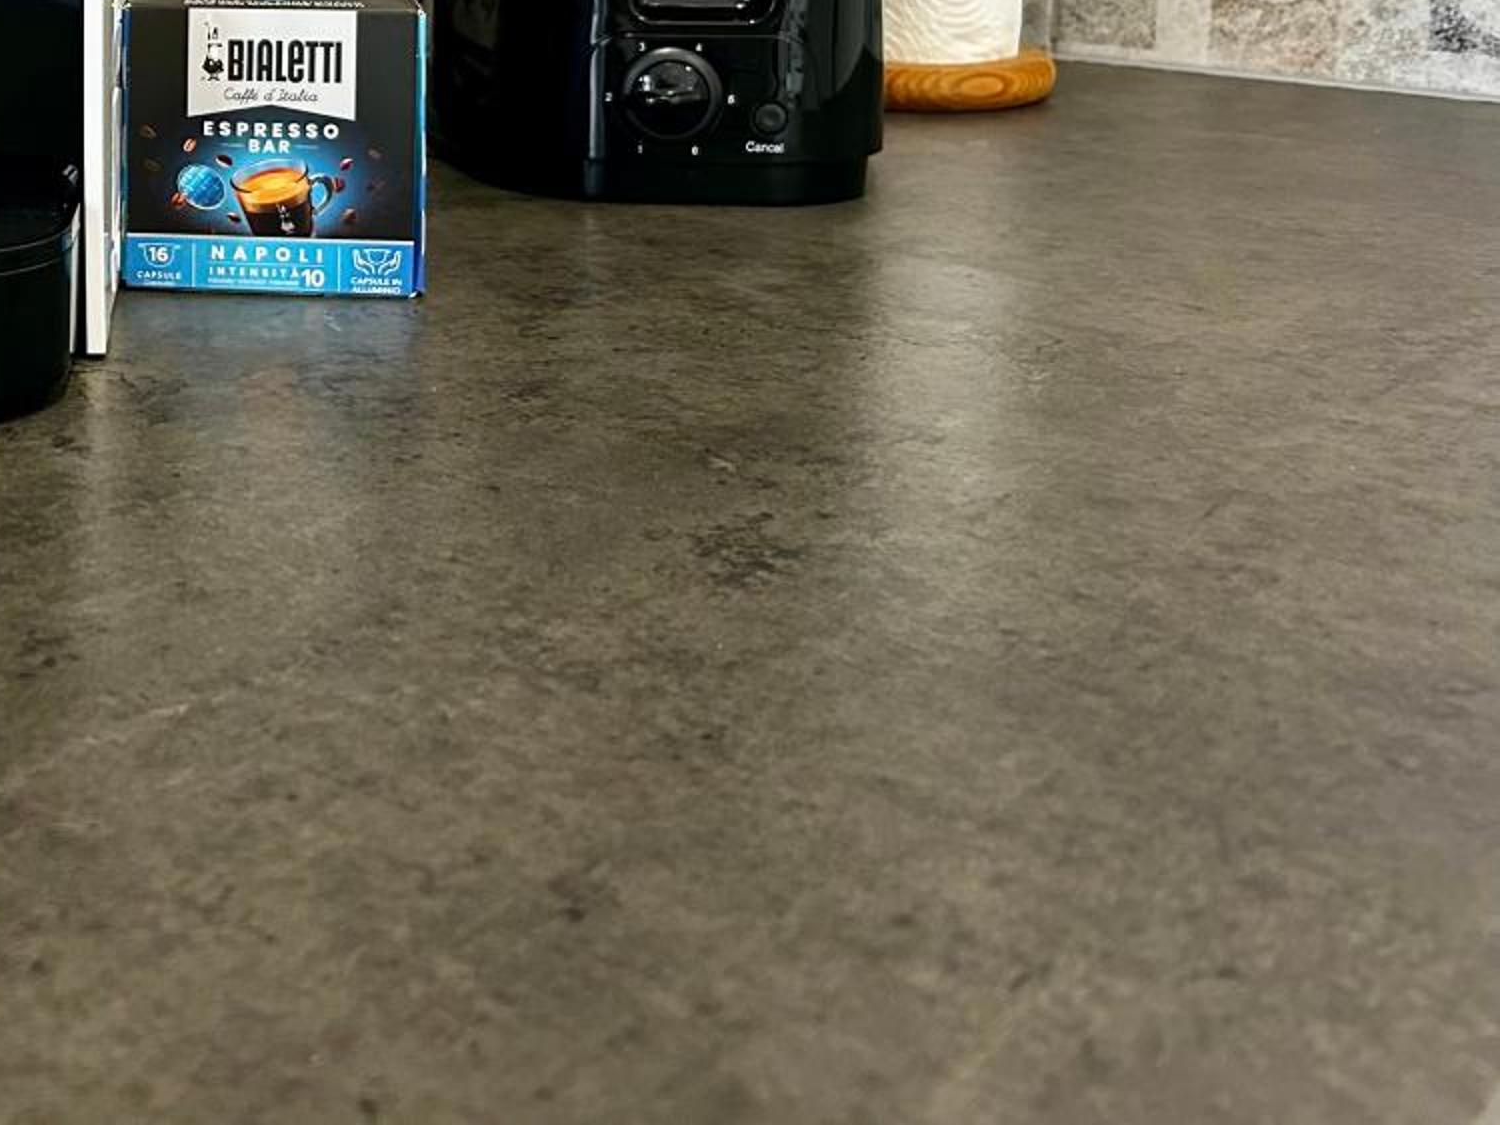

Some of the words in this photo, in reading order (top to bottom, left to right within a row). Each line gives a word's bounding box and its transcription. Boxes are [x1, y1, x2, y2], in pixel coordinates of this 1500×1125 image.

[227, 39, 343, 84] BIALETTI
[203, 121, 340, 139] ESPRESSO
[248, 139, 291, 154] BAR
[745, 140, 785, 154] Cancel
[148, 246, 169, 262] 16
[211, 244, 323, 264] NAPOLI
[301, 268, 325, 288] 10
